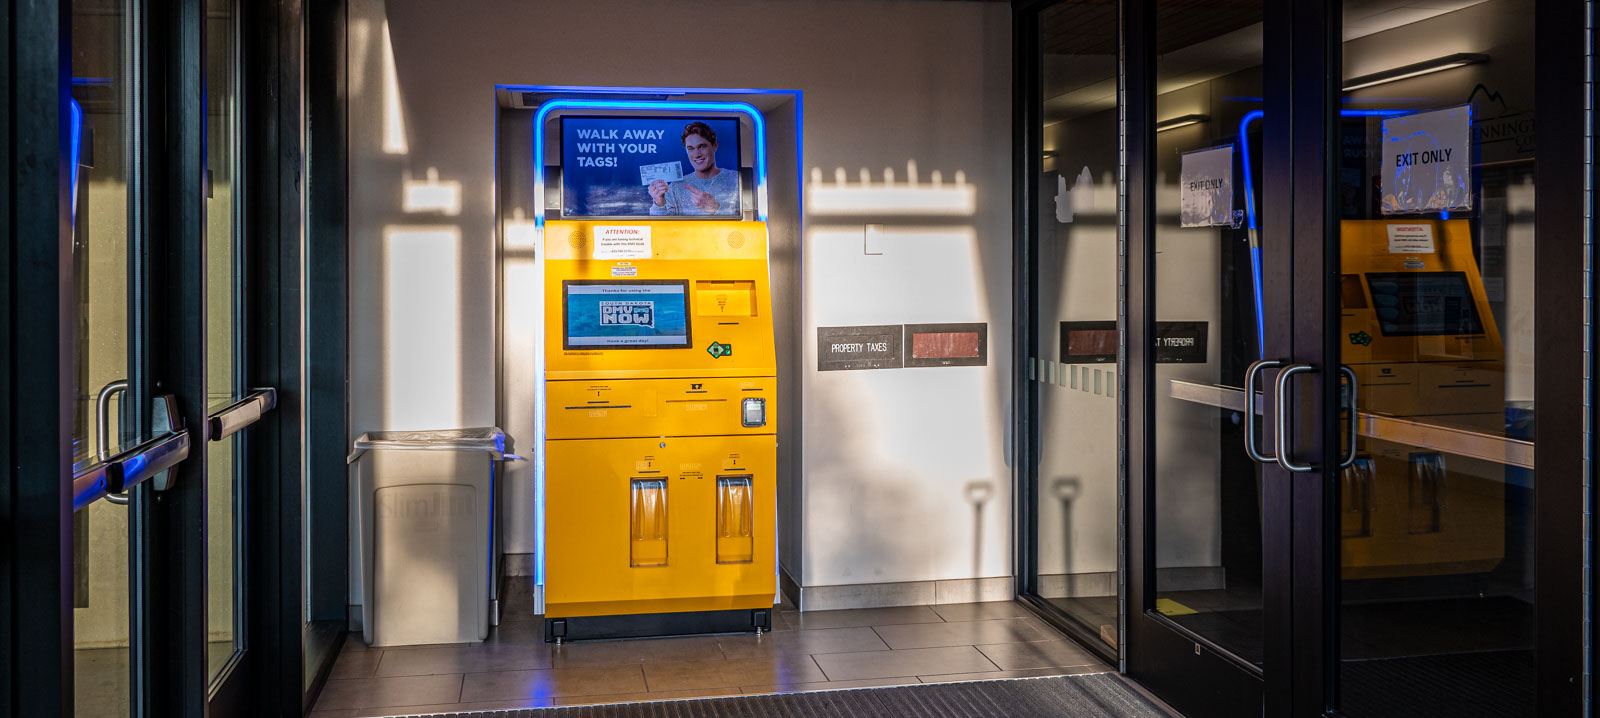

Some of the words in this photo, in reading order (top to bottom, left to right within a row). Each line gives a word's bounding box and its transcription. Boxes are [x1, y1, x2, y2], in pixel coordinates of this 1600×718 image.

[577, 129, 619, 140] WALK
[623, 129, 665, 140] AWAY
[577, 143, 615, 153] WITH
[618, 143, 657, 153] YOUR
[577, 156, 618, 167] TAGS!
[1396, 152, 1419, 168] EXIT
[1421, 149, 1452, 165] ONLY
[1190, 181, 1205, 192] EXIT
[1205, 178, 1223, 190] ONLY
[603, 313, 649, 324] NOW
[831, 343, 863, 353] PROPERTY
[867, 342, 887, 352] TAXES
